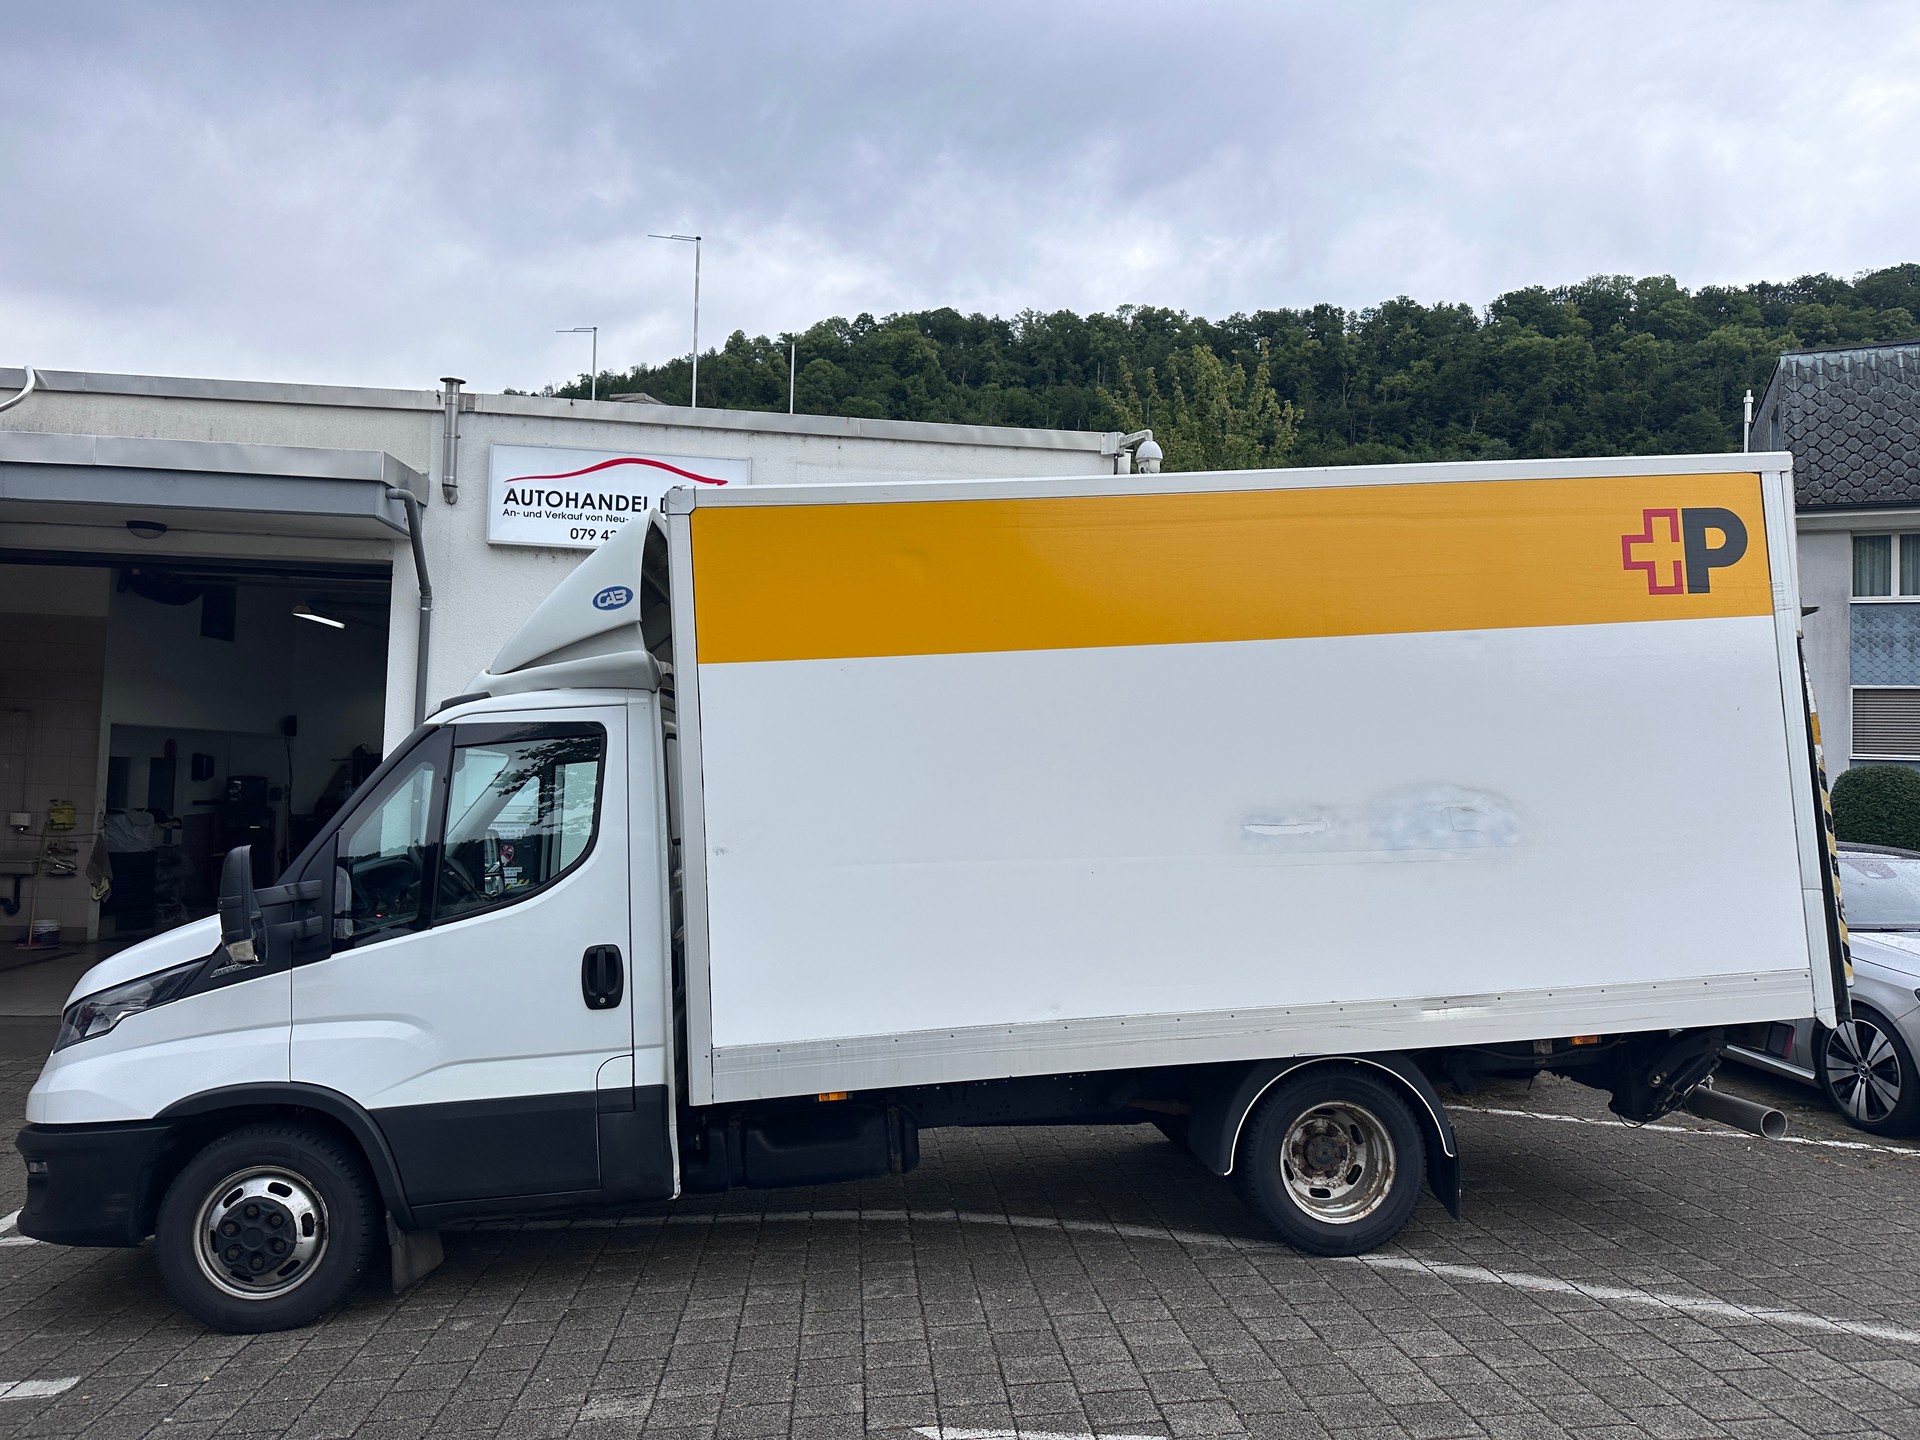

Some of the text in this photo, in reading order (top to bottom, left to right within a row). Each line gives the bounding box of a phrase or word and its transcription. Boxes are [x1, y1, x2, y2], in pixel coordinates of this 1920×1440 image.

[502, 508, 629, 523] An- und Verkauf von Neu-
[570, 527, 617, 541] 079 4
[1681, 507, 1748, 594] P
[597, 588, 627, 608] CAB
